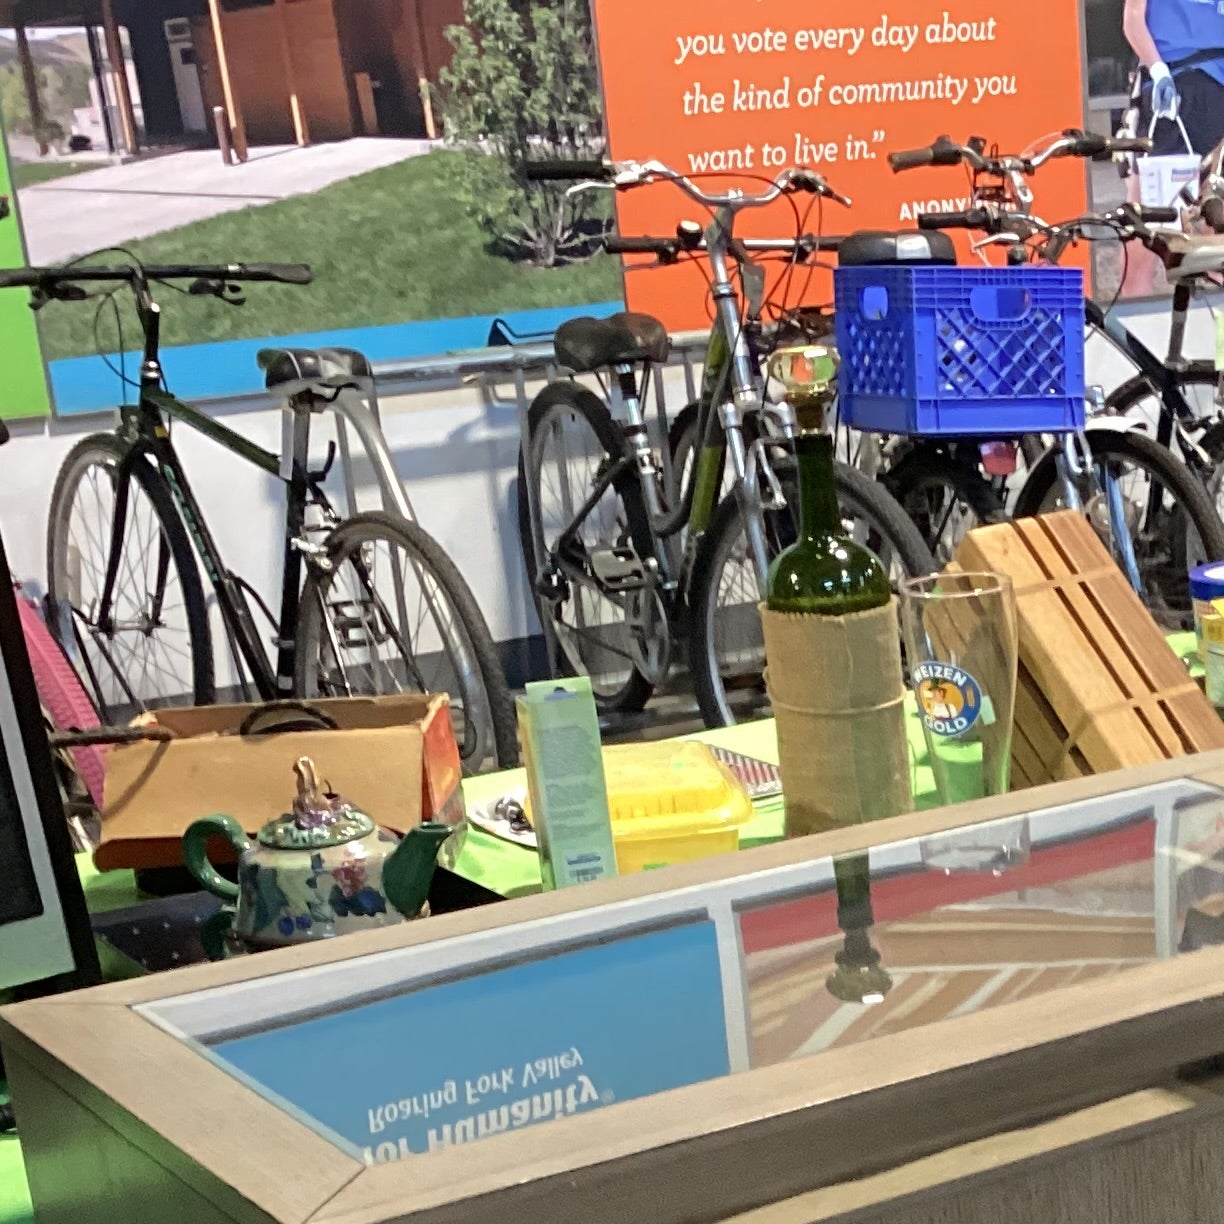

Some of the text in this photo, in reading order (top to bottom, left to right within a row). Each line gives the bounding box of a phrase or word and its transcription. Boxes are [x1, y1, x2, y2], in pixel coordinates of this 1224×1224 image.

[674, 11, 997, 64] you vote every day about
[682, 72, 1017, 116] the kind of community you
[687, 143, 756, 173] want
[761, 142, 787, 167] to
[794, 132, 839, 165] live
[924, 715, 968, 733] GOLD
